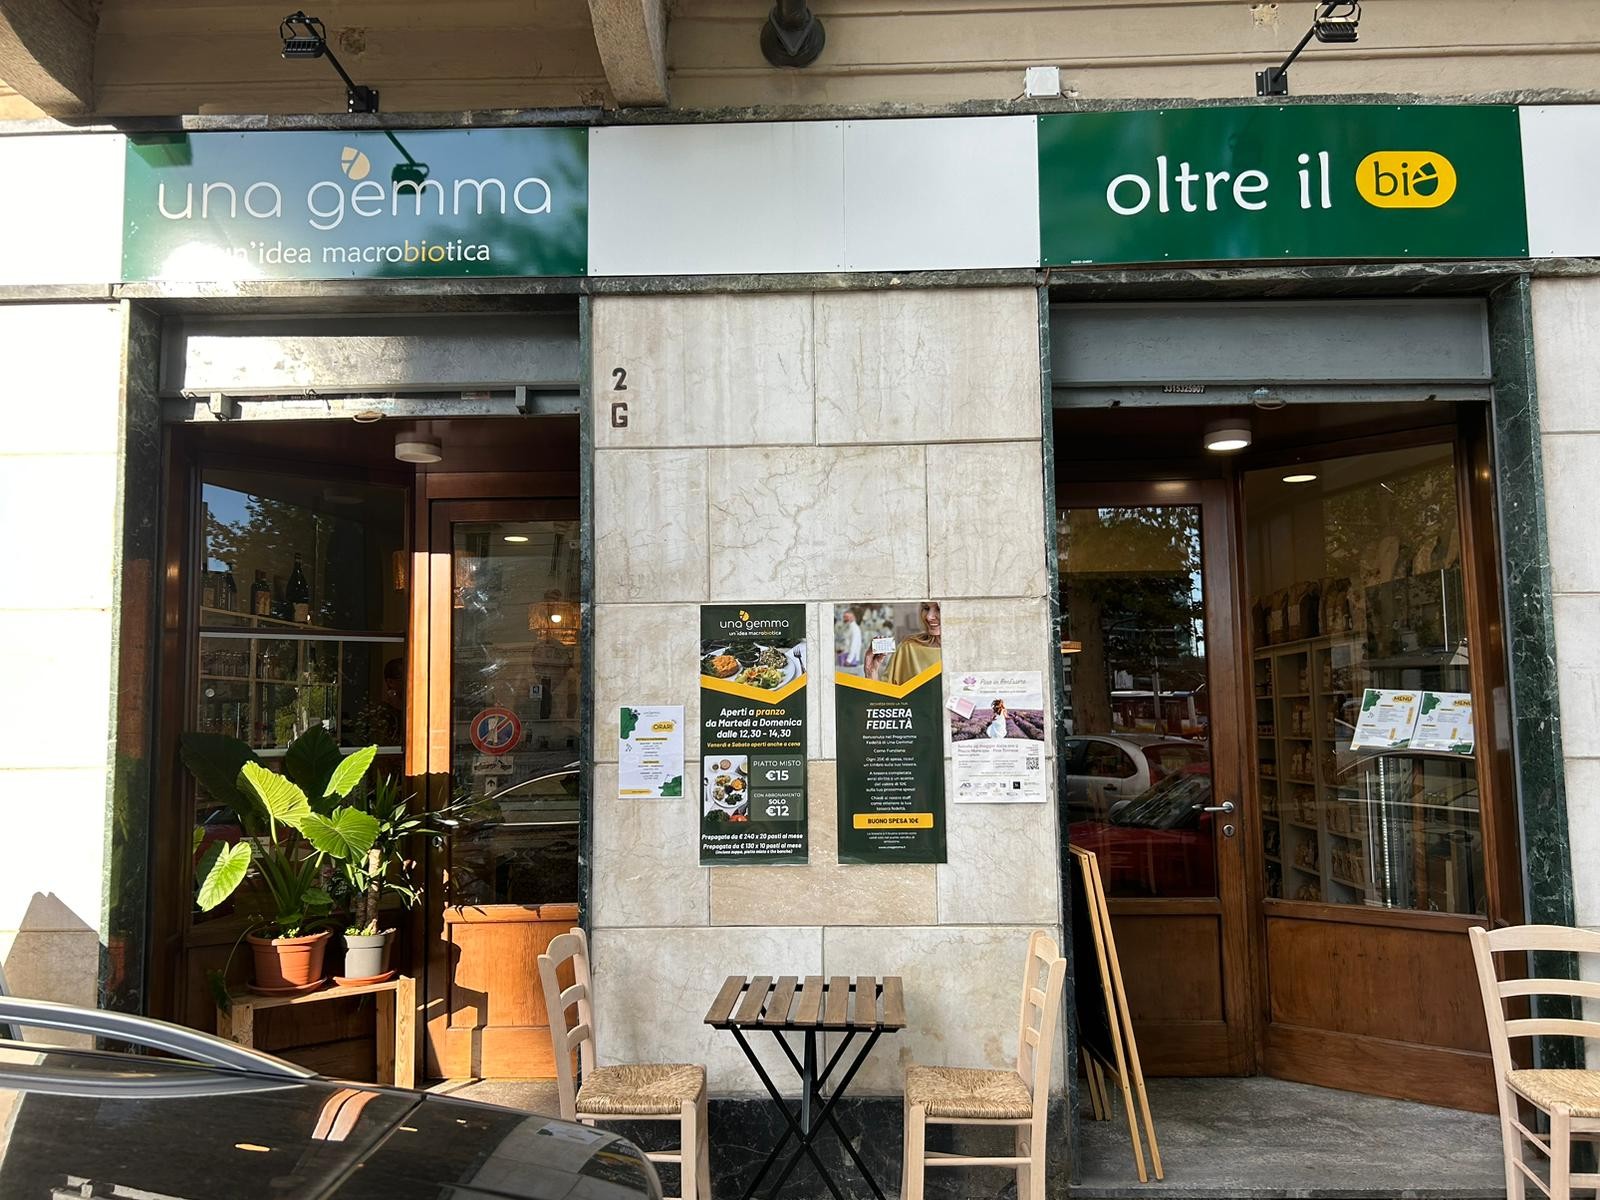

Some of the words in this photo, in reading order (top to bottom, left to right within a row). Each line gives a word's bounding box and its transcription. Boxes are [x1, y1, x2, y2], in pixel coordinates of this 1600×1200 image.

[1106, 154, 1269, 216] oltre
[1298, 151, 1333, 210] il
[157, 180, 282, 221] una
[306, 177, 552, 231] gemma
[322, 239, 490, 264] macrobiotica
[612, 367, 628, 391] 2
[611, 402, 628, 428] G
[720, 620, 742, 629] una
[746, 620, 790, 630] gemma
[720, 708, 747, 717] Aperti
[756, 708, 786, 717] pranzo
[866, 708, 912, 718] TESSERA
[718, 719, 750, 727] Martedì
[759, 718, 802, 727] Domenica
[866, 718, 912, 729] FEDELTÀ
[716, 730, 737, 738] dalle
[766, 770, 789, 781] €15
[766, 806, 789, 816] €12
